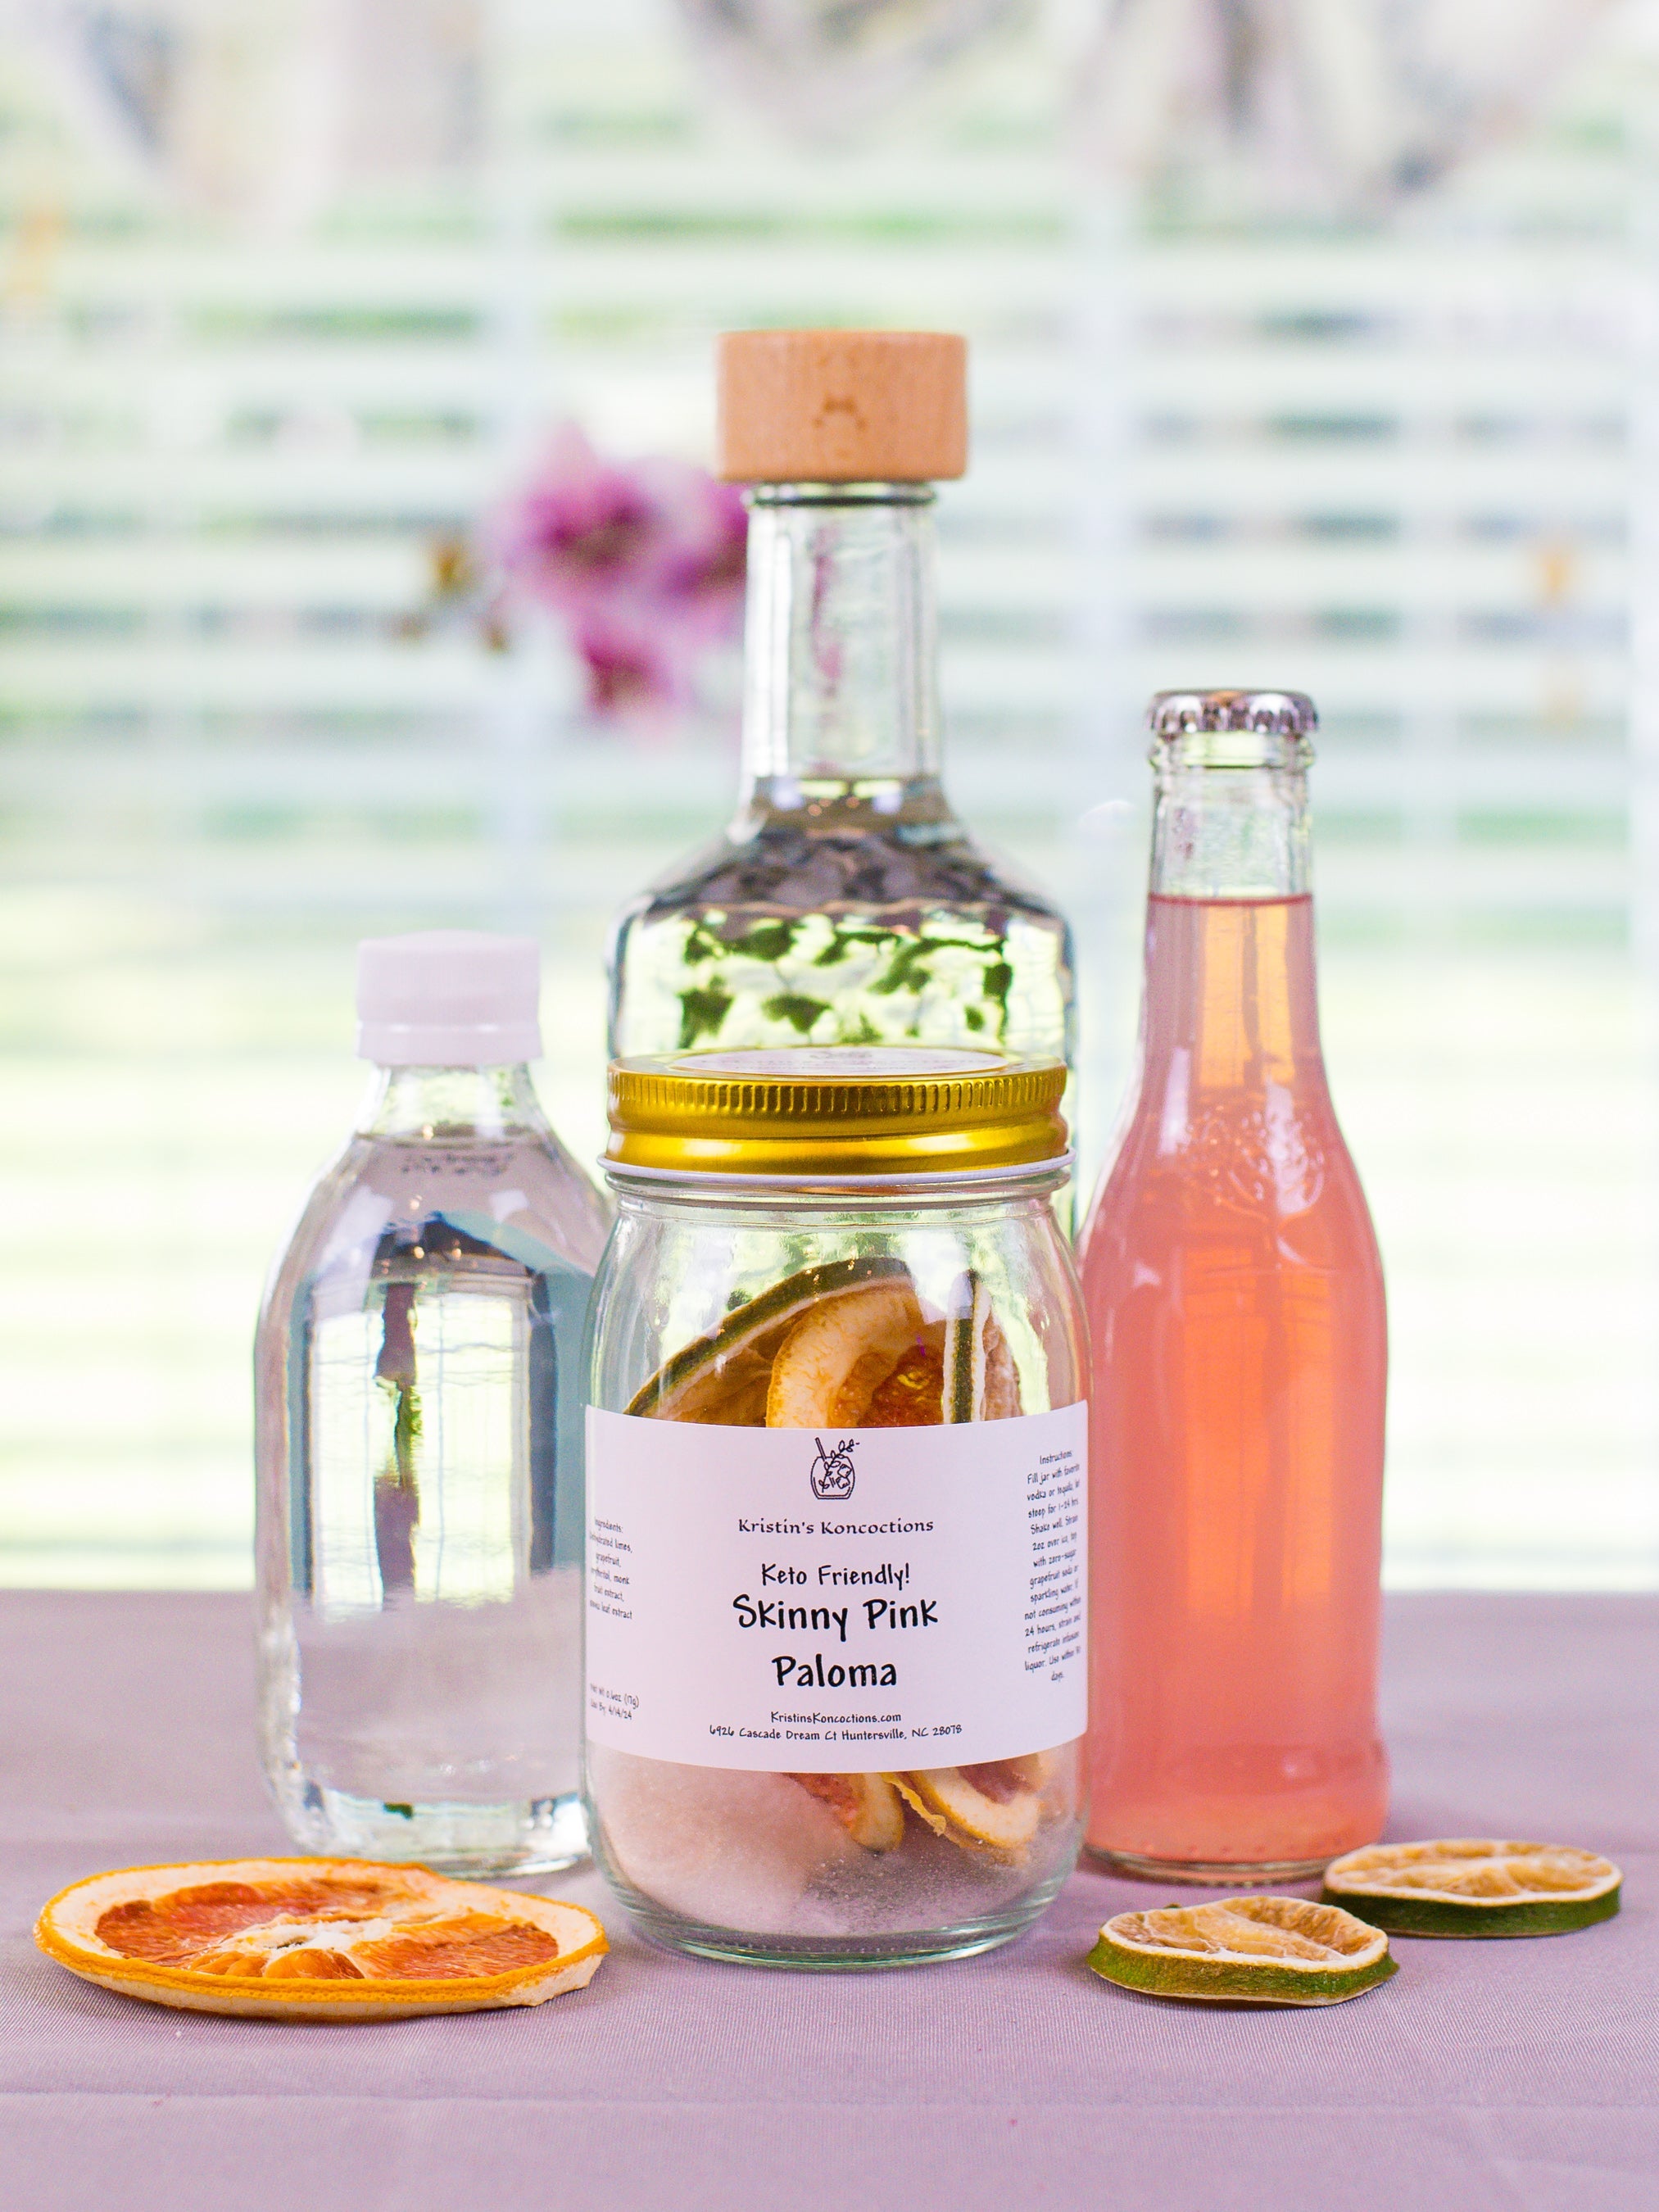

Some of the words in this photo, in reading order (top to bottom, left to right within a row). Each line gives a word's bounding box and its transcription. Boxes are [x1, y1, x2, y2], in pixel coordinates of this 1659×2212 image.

[1027, 1473, 1038, 1484] Fill
[1040, 1473, 1049, 1484] jar
[1027, 1489, 1046, 1502] vodka
[1028, 1507, 1045, 1519] steep
[1048, 1503, 1056, 1515] for
[739, 1518, 814, 1534] Kristin's
[821, 1518, 934, 1534] Koncoctions
[1031, 1523, 1049, 1534] Shake
[615, 1539, 632, 1553] limes,
[1047, 1538, 1059, 1548] over
[1033, 1557, 1046, 1567] with
[614, 1575, 629, 1584] monk
[762, 1563, 808, 1586] Keto
[818, 1562, 910, 1591] Friendly!
[1030, 1570, 1060, 1589] grapefruit
[1030, 1589, 1059, 1605] sparkling
[612, 1608, 632, 1619] extract
[733, 1594, 848, 1642] Skinny
[863, 1599, 938, 1630] Pink
[1024, 1610, 1036, 1620] not
[1038, 1602, 1068, 1618] consuming
[1025, 1625, 1035, 1637] 24
[772, 1653, 897, 1687] Paloma
[1024, 1660, 1048, 1674] liquor.
[1049, 1654, 1059, 1666] Use
[771, 1711, 902, 1724] KristinsKoncoctions.com
[709, 1725, 735, 1737] 6926
[739, 1728, 782, 1739] Cascade
[786, 1730, 820, 1741] Dream
[825, 1730, 836, 1741] Ct
[841, 1729, 907, 1741] Huntersville,
[912, 1727, 929, 1738] NC
[932, 1724, 963, 1736] 28078
